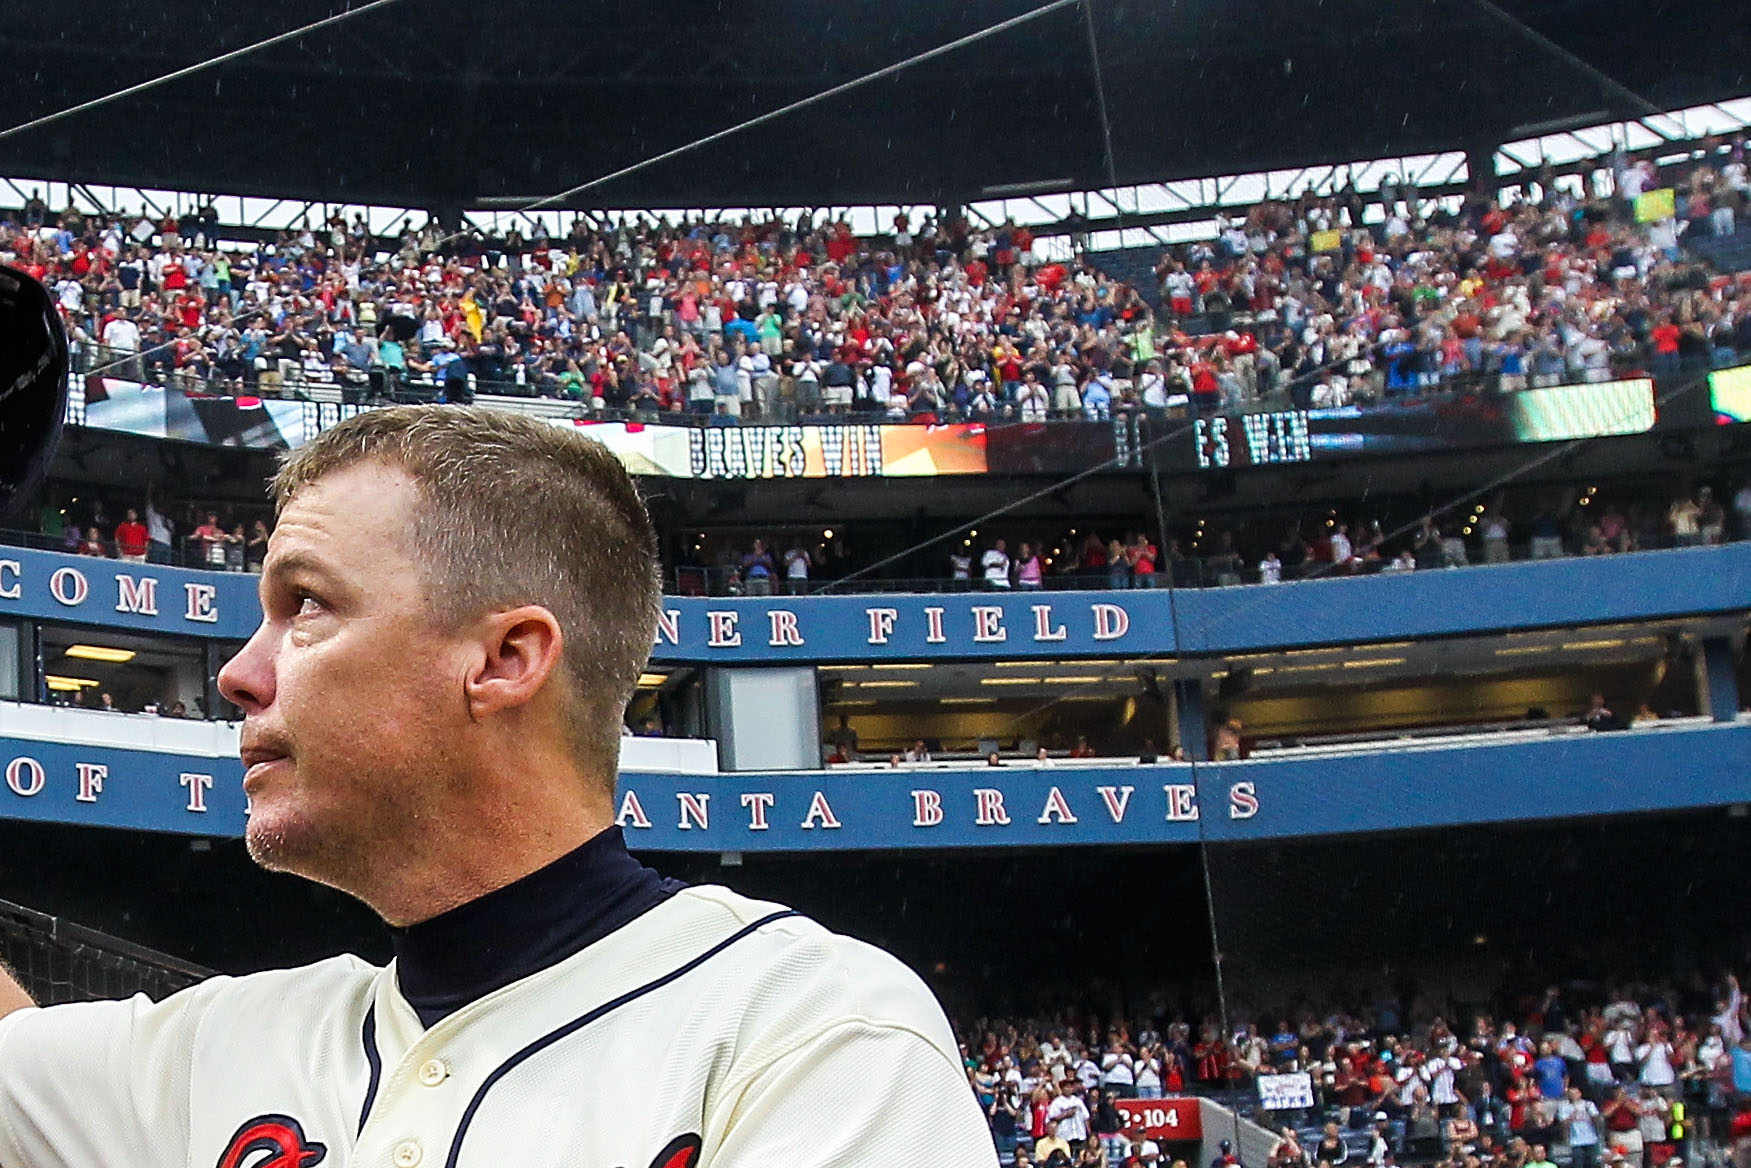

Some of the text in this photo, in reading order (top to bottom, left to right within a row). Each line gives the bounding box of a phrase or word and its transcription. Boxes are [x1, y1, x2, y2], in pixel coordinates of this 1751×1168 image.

[689, 425, 883, 478] BRAVES WIN
[1242, 409, 1311, 465] WIN
[866, 603, 1130, 645] FIELD
[5, 756, 109, 803] OF
[911, 781, 1260, 828] BRAVES
